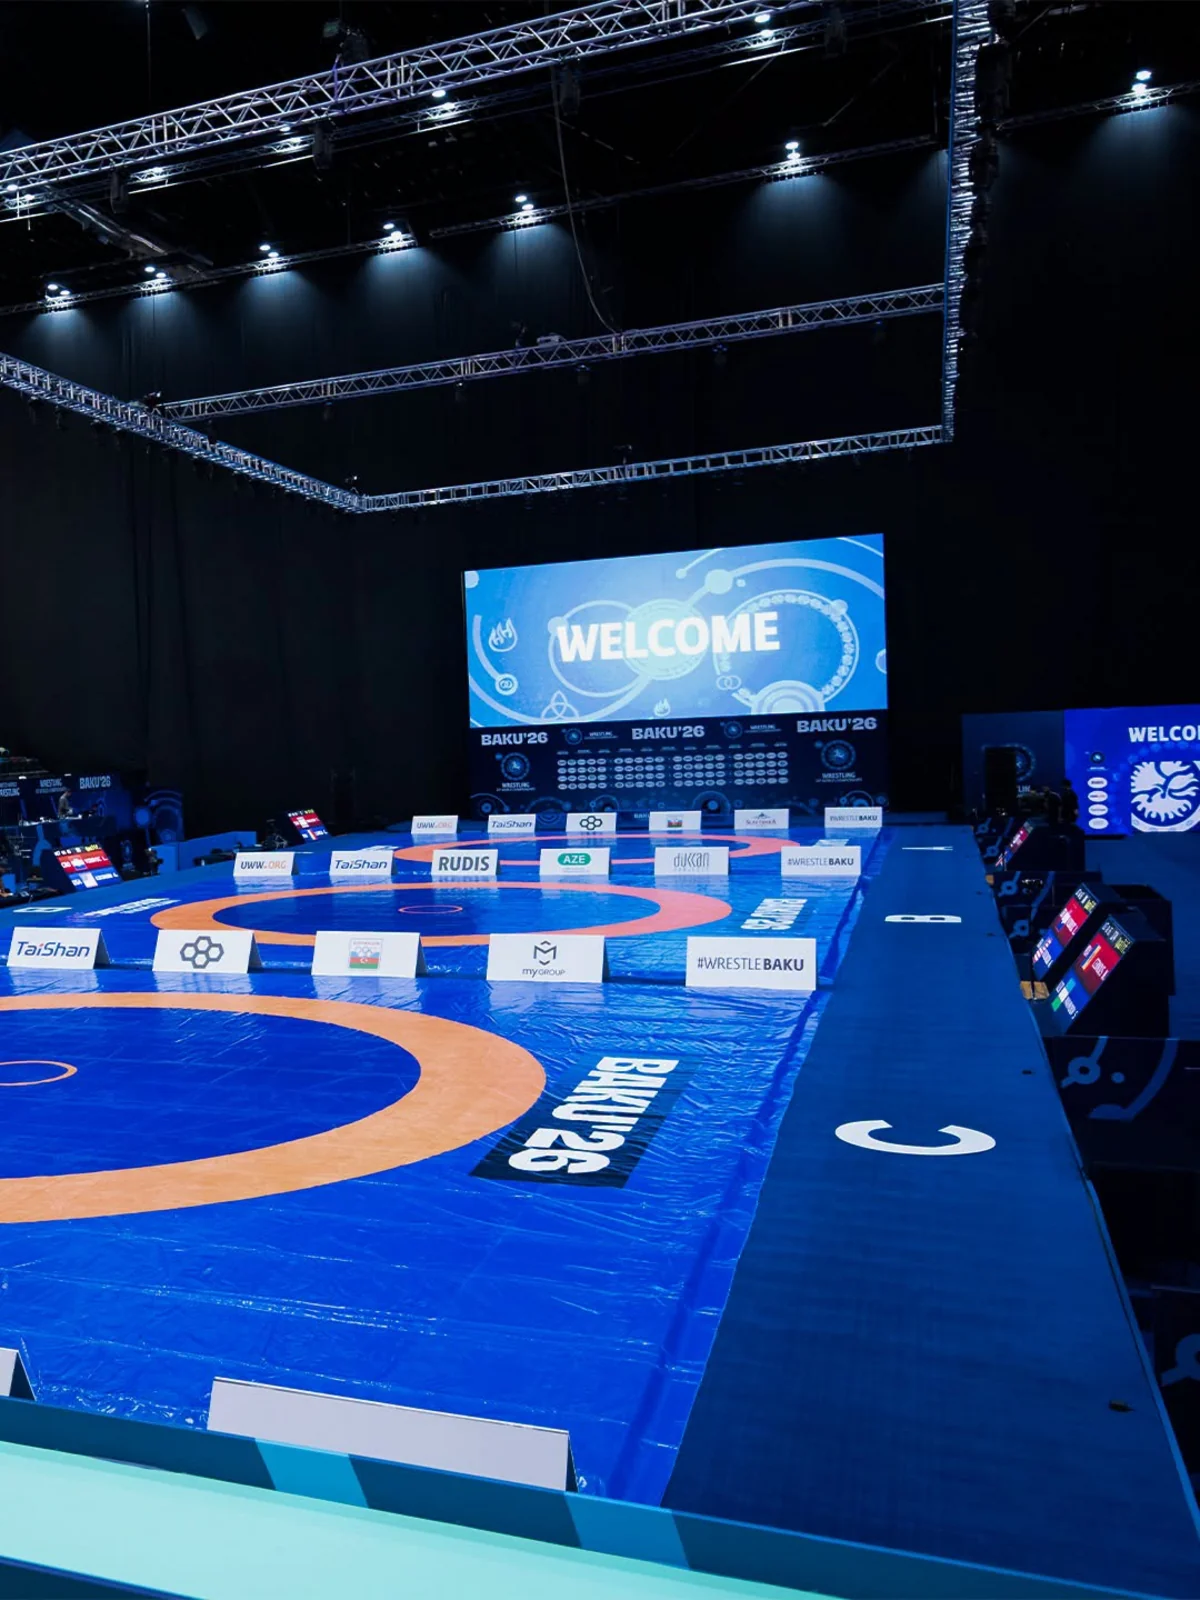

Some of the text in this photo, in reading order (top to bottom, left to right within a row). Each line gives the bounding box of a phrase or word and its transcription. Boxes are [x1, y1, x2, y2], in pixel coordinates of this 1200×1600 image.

[556, 611, 780, 663] WELCOME
[631, 725, 705, 740] BAKU'26
[796, 717, 877, 733] BAKU'26
[481, 731, 548, 746] BAKU'26
[1128, 725, 1200, 742] WELCO
[79, 776, 111, 790] BAKU'26
[491, 819, 532, 829] TaiShan
[240, 860, 287, 870] UWW.ORG
[335, 859, 388, 870] TaiShan
[438, 856, 490, 872] RUDIS
[562, 855, 586, 864] AZE
[787, 856, 854, 867] #WRESTLEBAKU
[16, 941, 91, 958] TaiShan
[697, 956, 805, 972] #WRESTLEBAKU
[508, 1056, 680, 1174] BAKU'26
[834, 1119, 997, 1156] C
